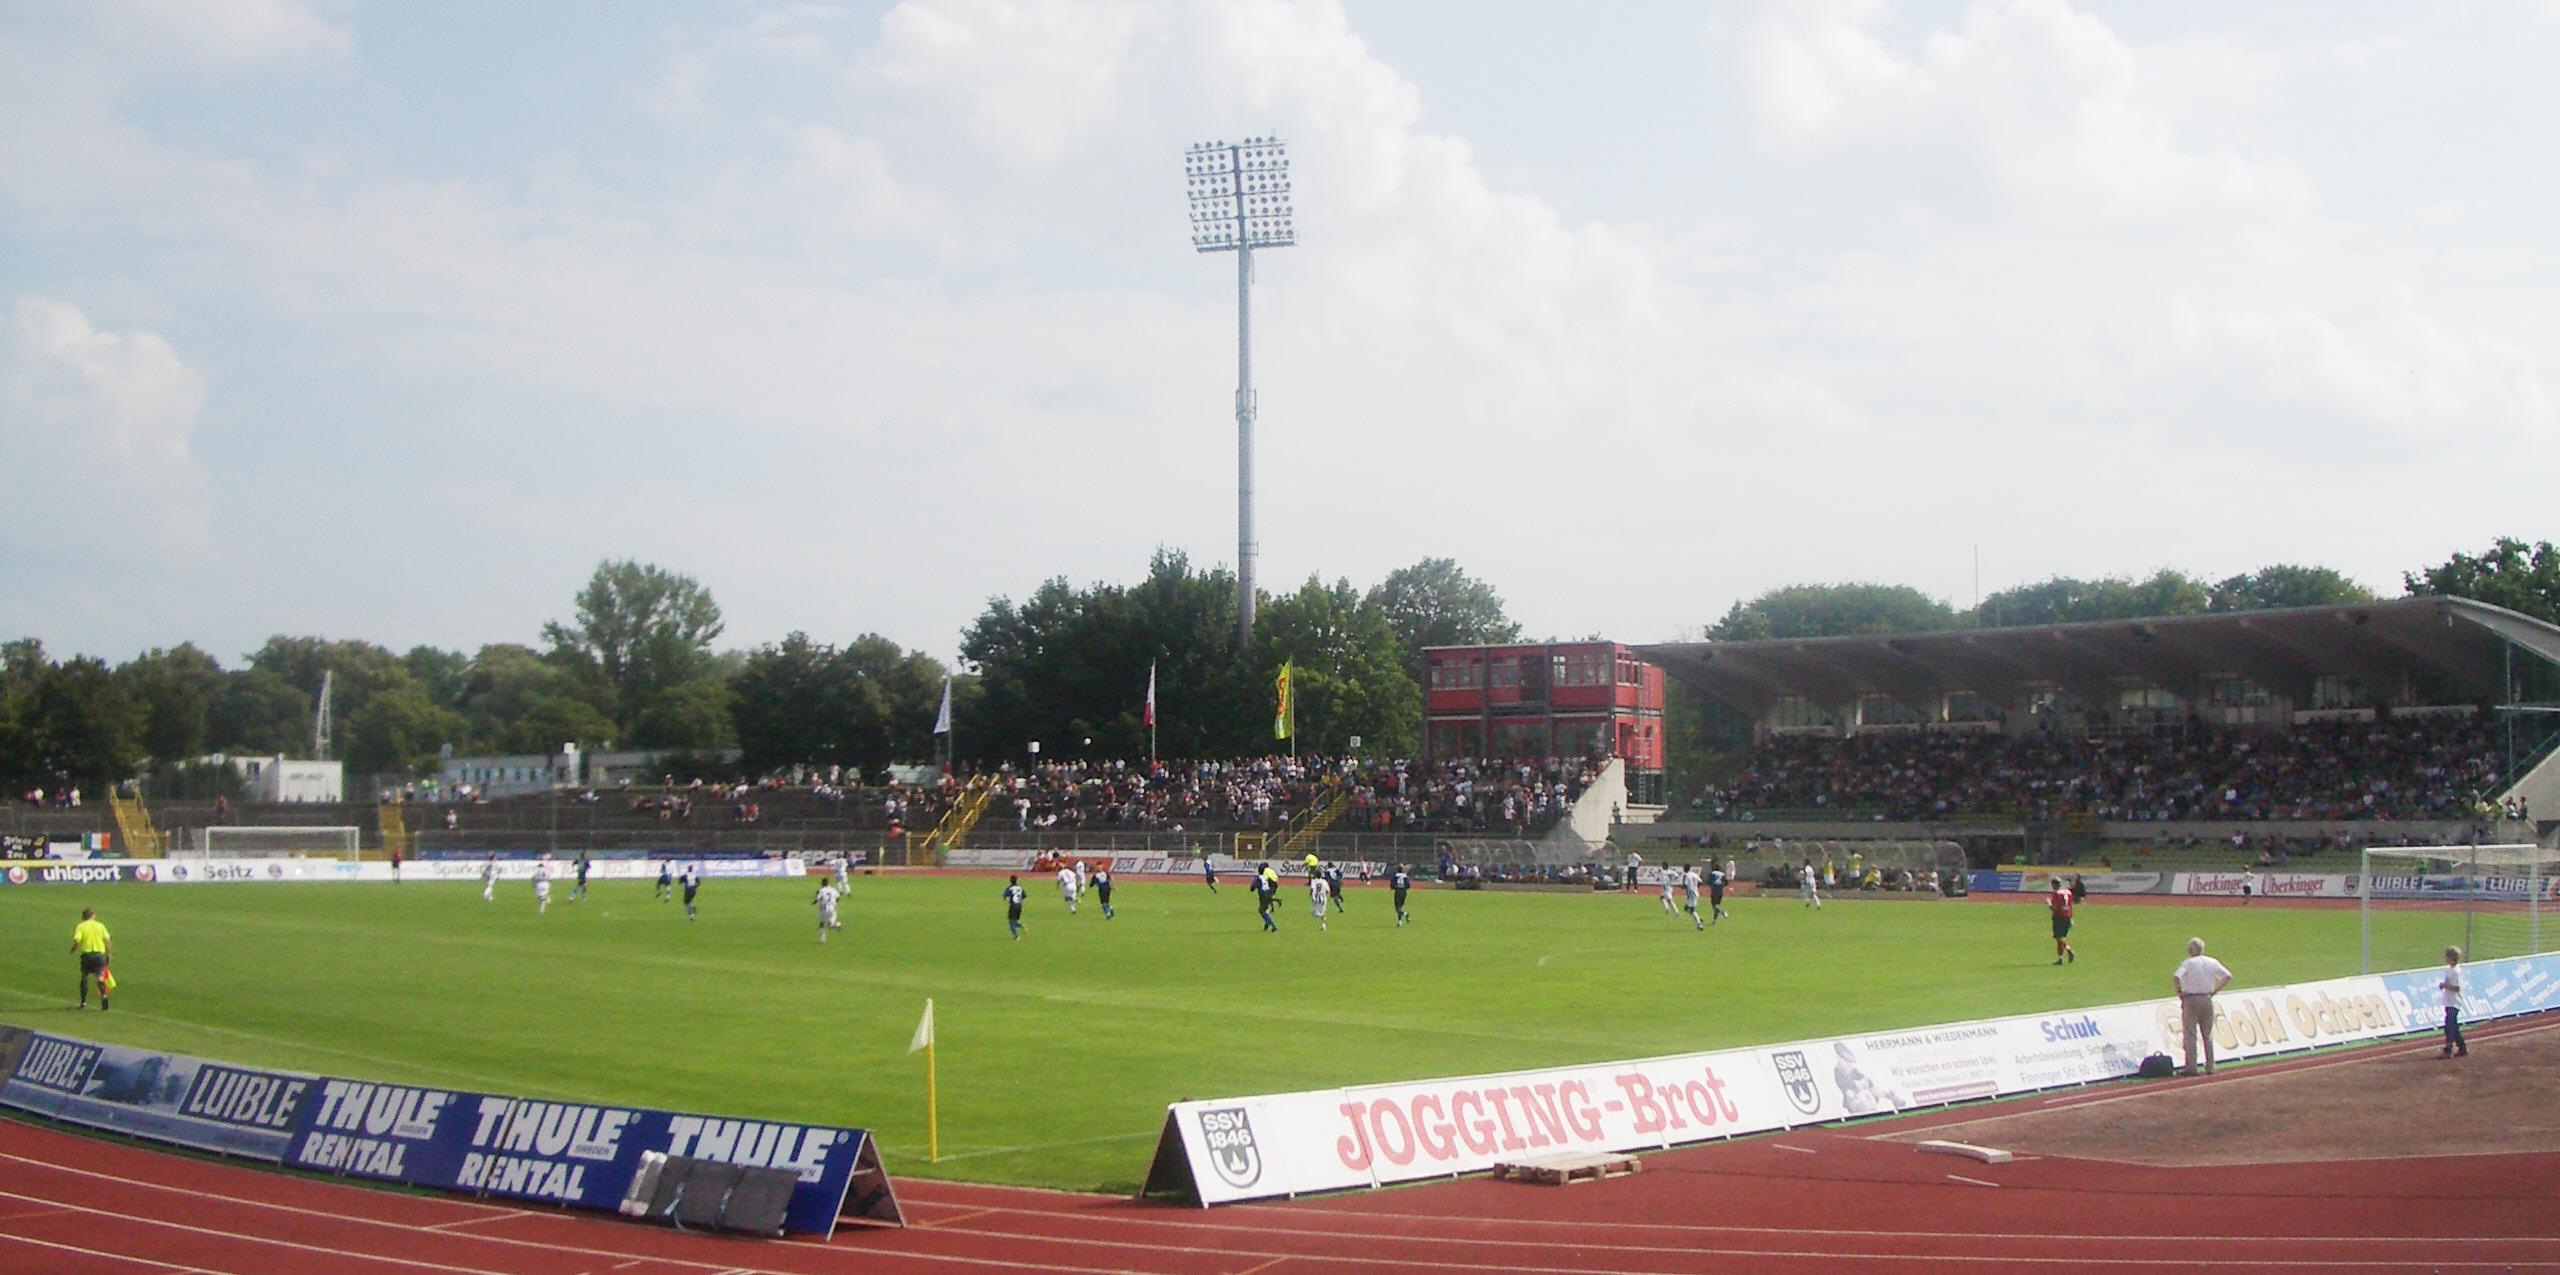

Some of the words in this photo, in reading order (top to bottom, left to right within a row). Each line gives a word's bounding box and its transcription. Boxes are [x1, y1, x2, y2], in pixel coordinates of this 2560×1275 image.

[43, 865, 121, 883] uhlsport
[204, 864, 254, 879] Seitz
[2261, 873, 2325, 895] Überkinger
[2040, 1015, 2102, 1042] Schuk
[2212, 998, 2289, 1050] Gold
[2287, 991, 2394, 1039] Ochsen
[2390, 990, 2445, 1027] Parke
[1866, 1036, 1922, 1050] HERRMANN
[1934, 1026, 1998, 1043] WIEDENMANN
[18, 1038, 95, 1090] LUIBLE
[1775, 1053, 1803, 1070] SSV
[189, 1069, 306, 1127] LUIBLE
[316, 1080, 448, 1139] THULE
[472, 1097, 631, 1161] THULE
[1203, 1111, 1244, 1131] SSV
[1207, 1128, 1252, 1149] 1846
[1337, 1067, 1739, 1171] JOGGING-Brot
[299, 1131, 406, 1177] RENTAL
[668, 1115, 837, 1184] THULE
[457, 1152, 585, 1200] RENTAL
